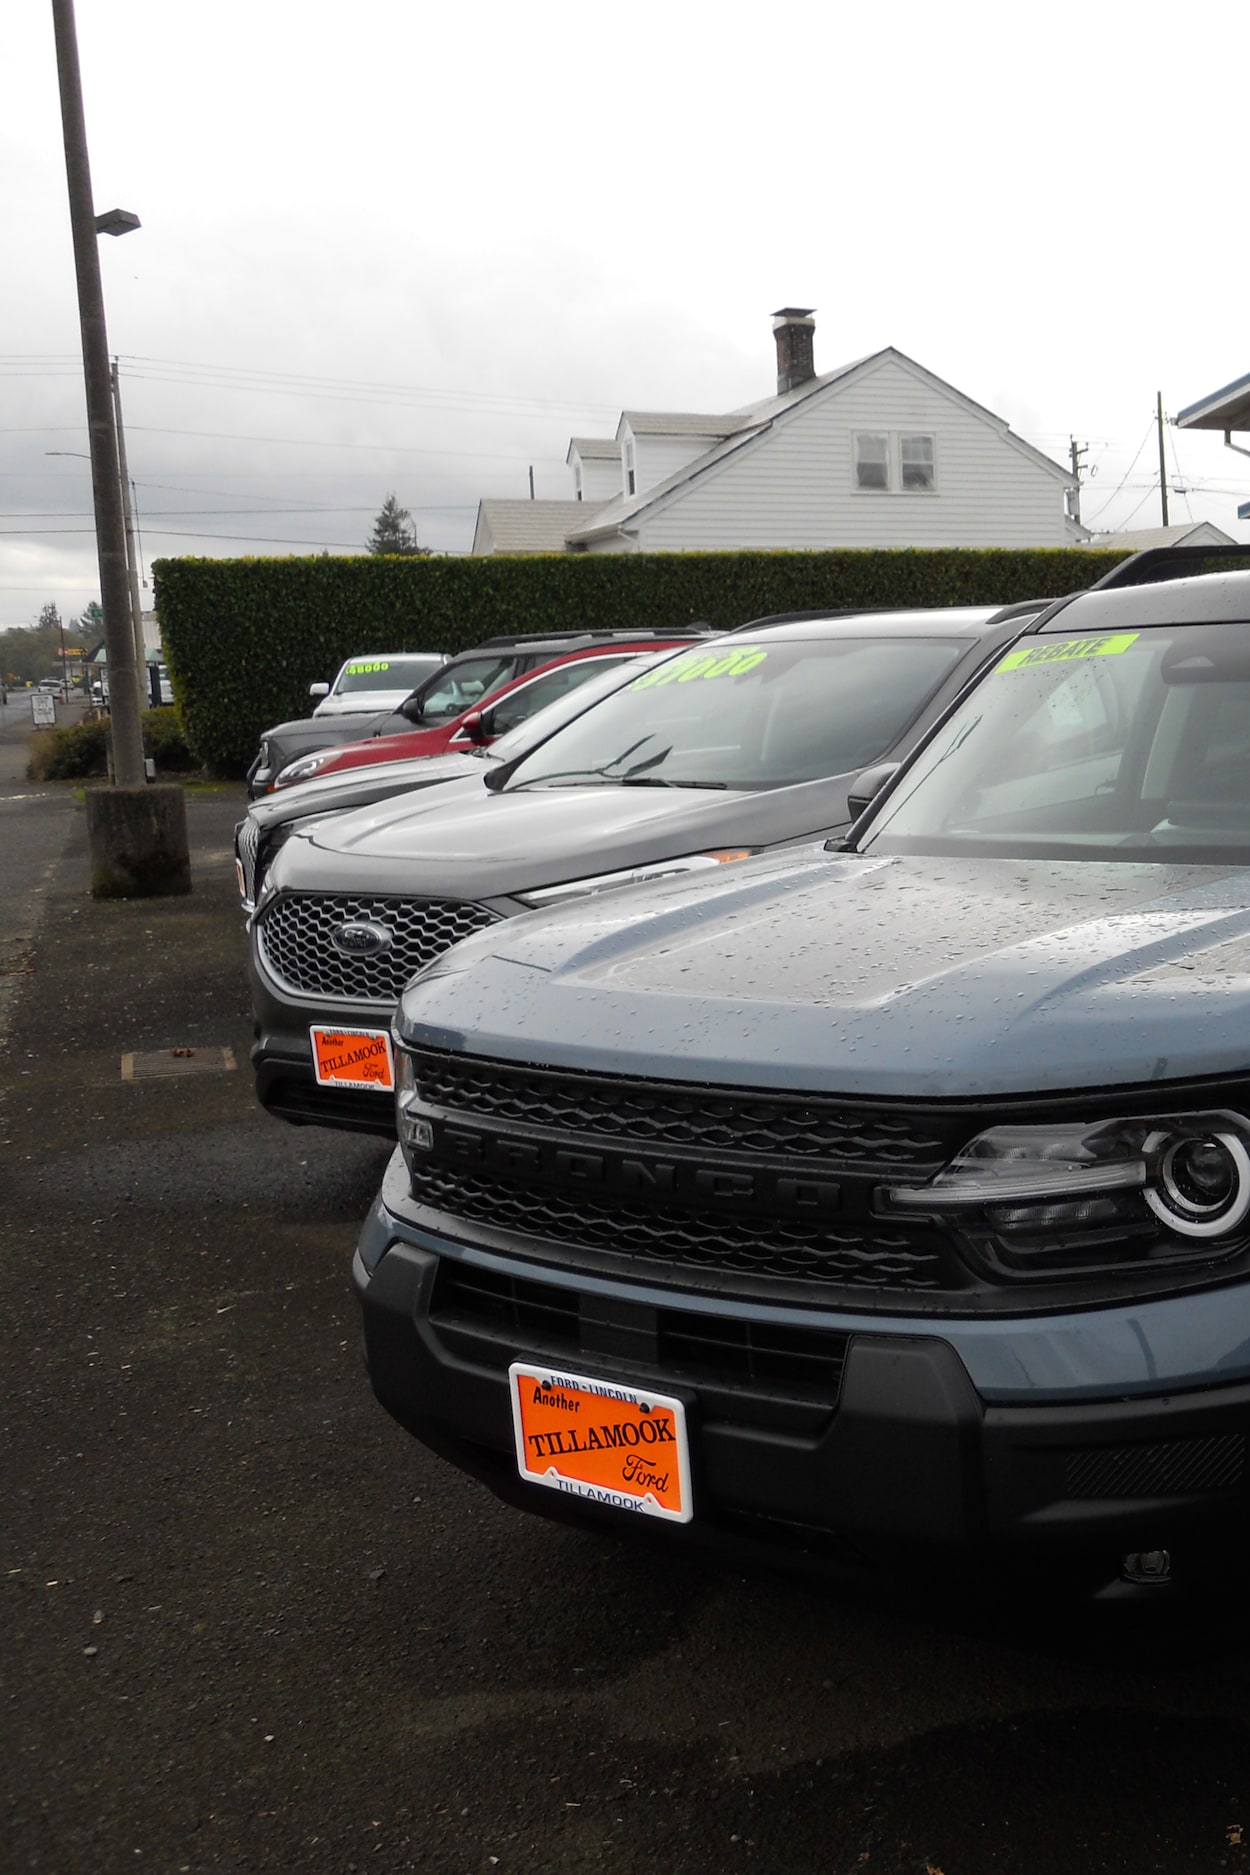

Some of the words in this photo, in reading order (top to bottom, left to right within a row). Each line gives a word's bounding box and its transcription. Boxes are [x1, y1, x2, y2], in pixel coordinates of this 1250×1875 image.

[1017, 636, 1114, 667] REBATE
[320, 1040, 387, 1073] TILLAMOOK
[362, 1062, 384, 1079] Ford
[442, 1128, 842, 1214] BRONCO
[532, 1386, 581, 1413] Another
[550, 1375, 580, 1391] FORD
[589, 1384, 637, 1404] LINCOLN
[528, 1417, 677, 1458] TILLAMOOK
[621, 1454, 669, 1493] Ford
[556, 1479, 646, 1513] TILLAMOOK
